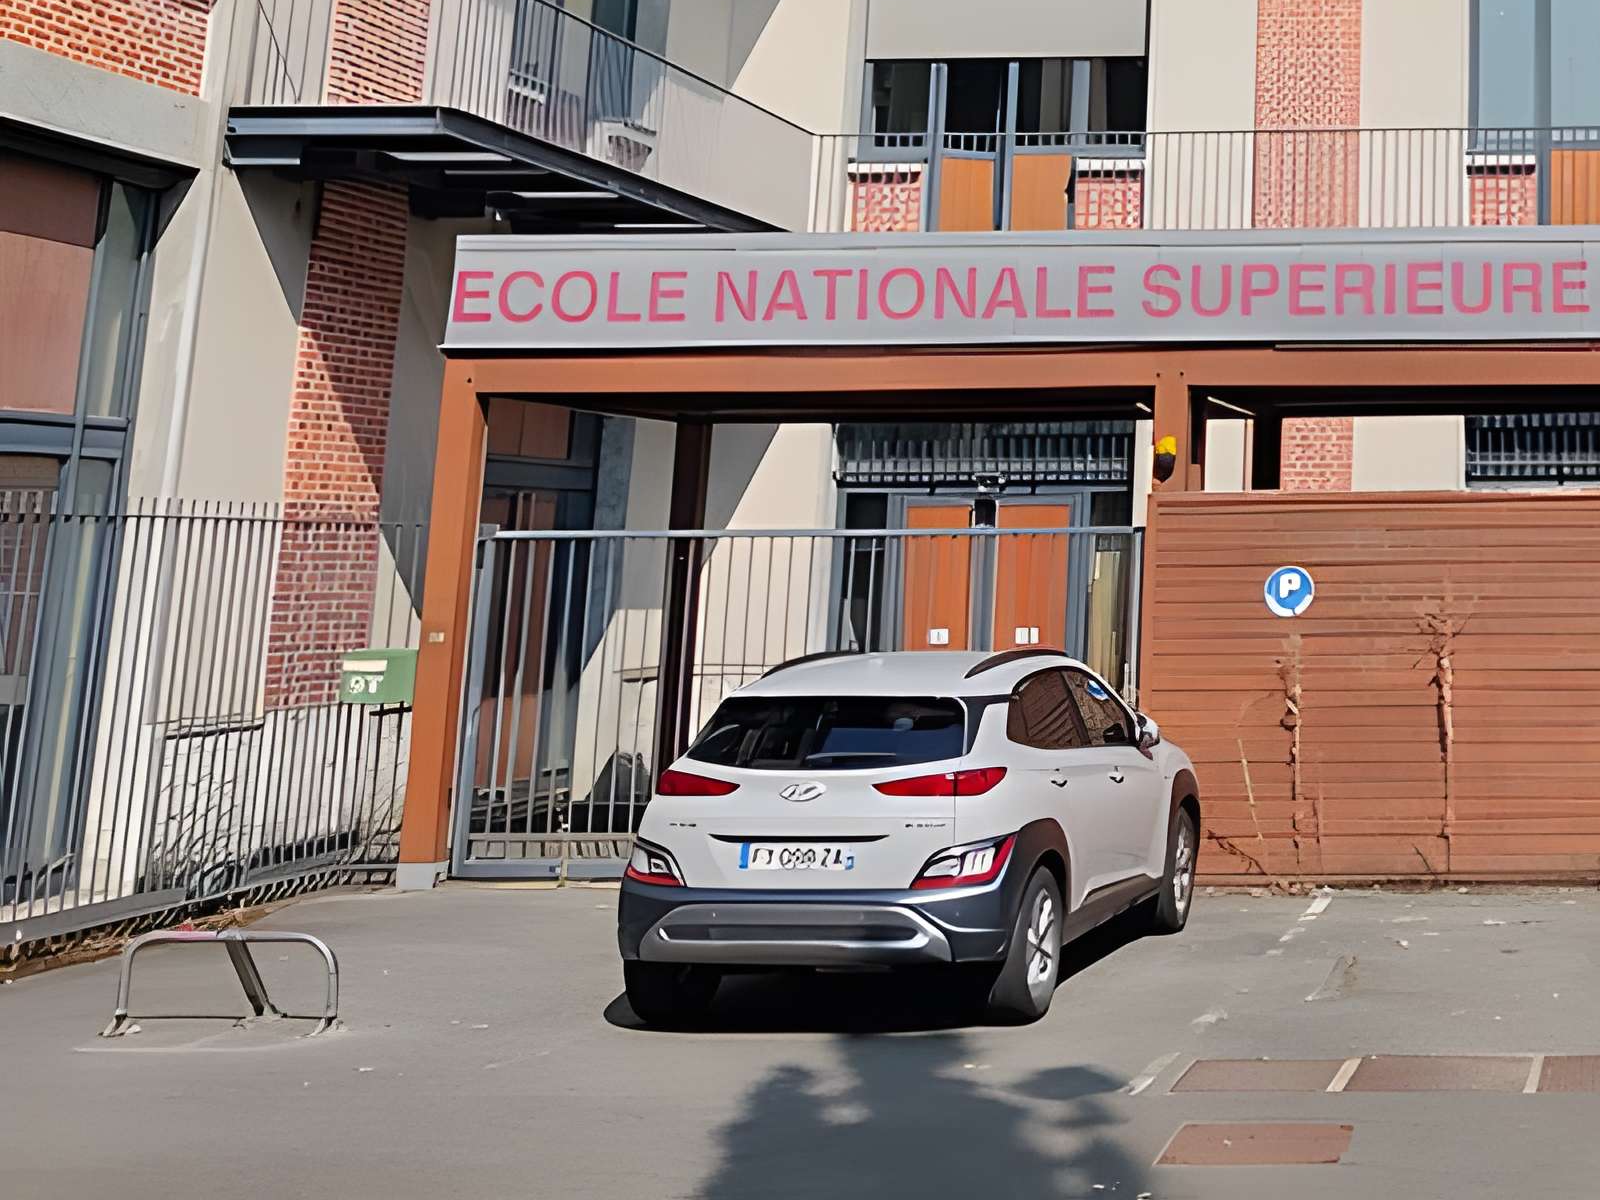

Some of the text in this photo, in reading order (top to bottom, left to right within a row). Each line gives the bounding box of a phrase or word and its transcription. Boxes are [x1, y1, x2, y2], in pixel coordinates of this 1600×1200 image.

[452, 269, 688, 325] ECOLE
[713, 265, 1117, 324] NATIONALE
[1141, 260, 1592, 318] SUPERIEURE
[1279, 573, 1301, 599] P
